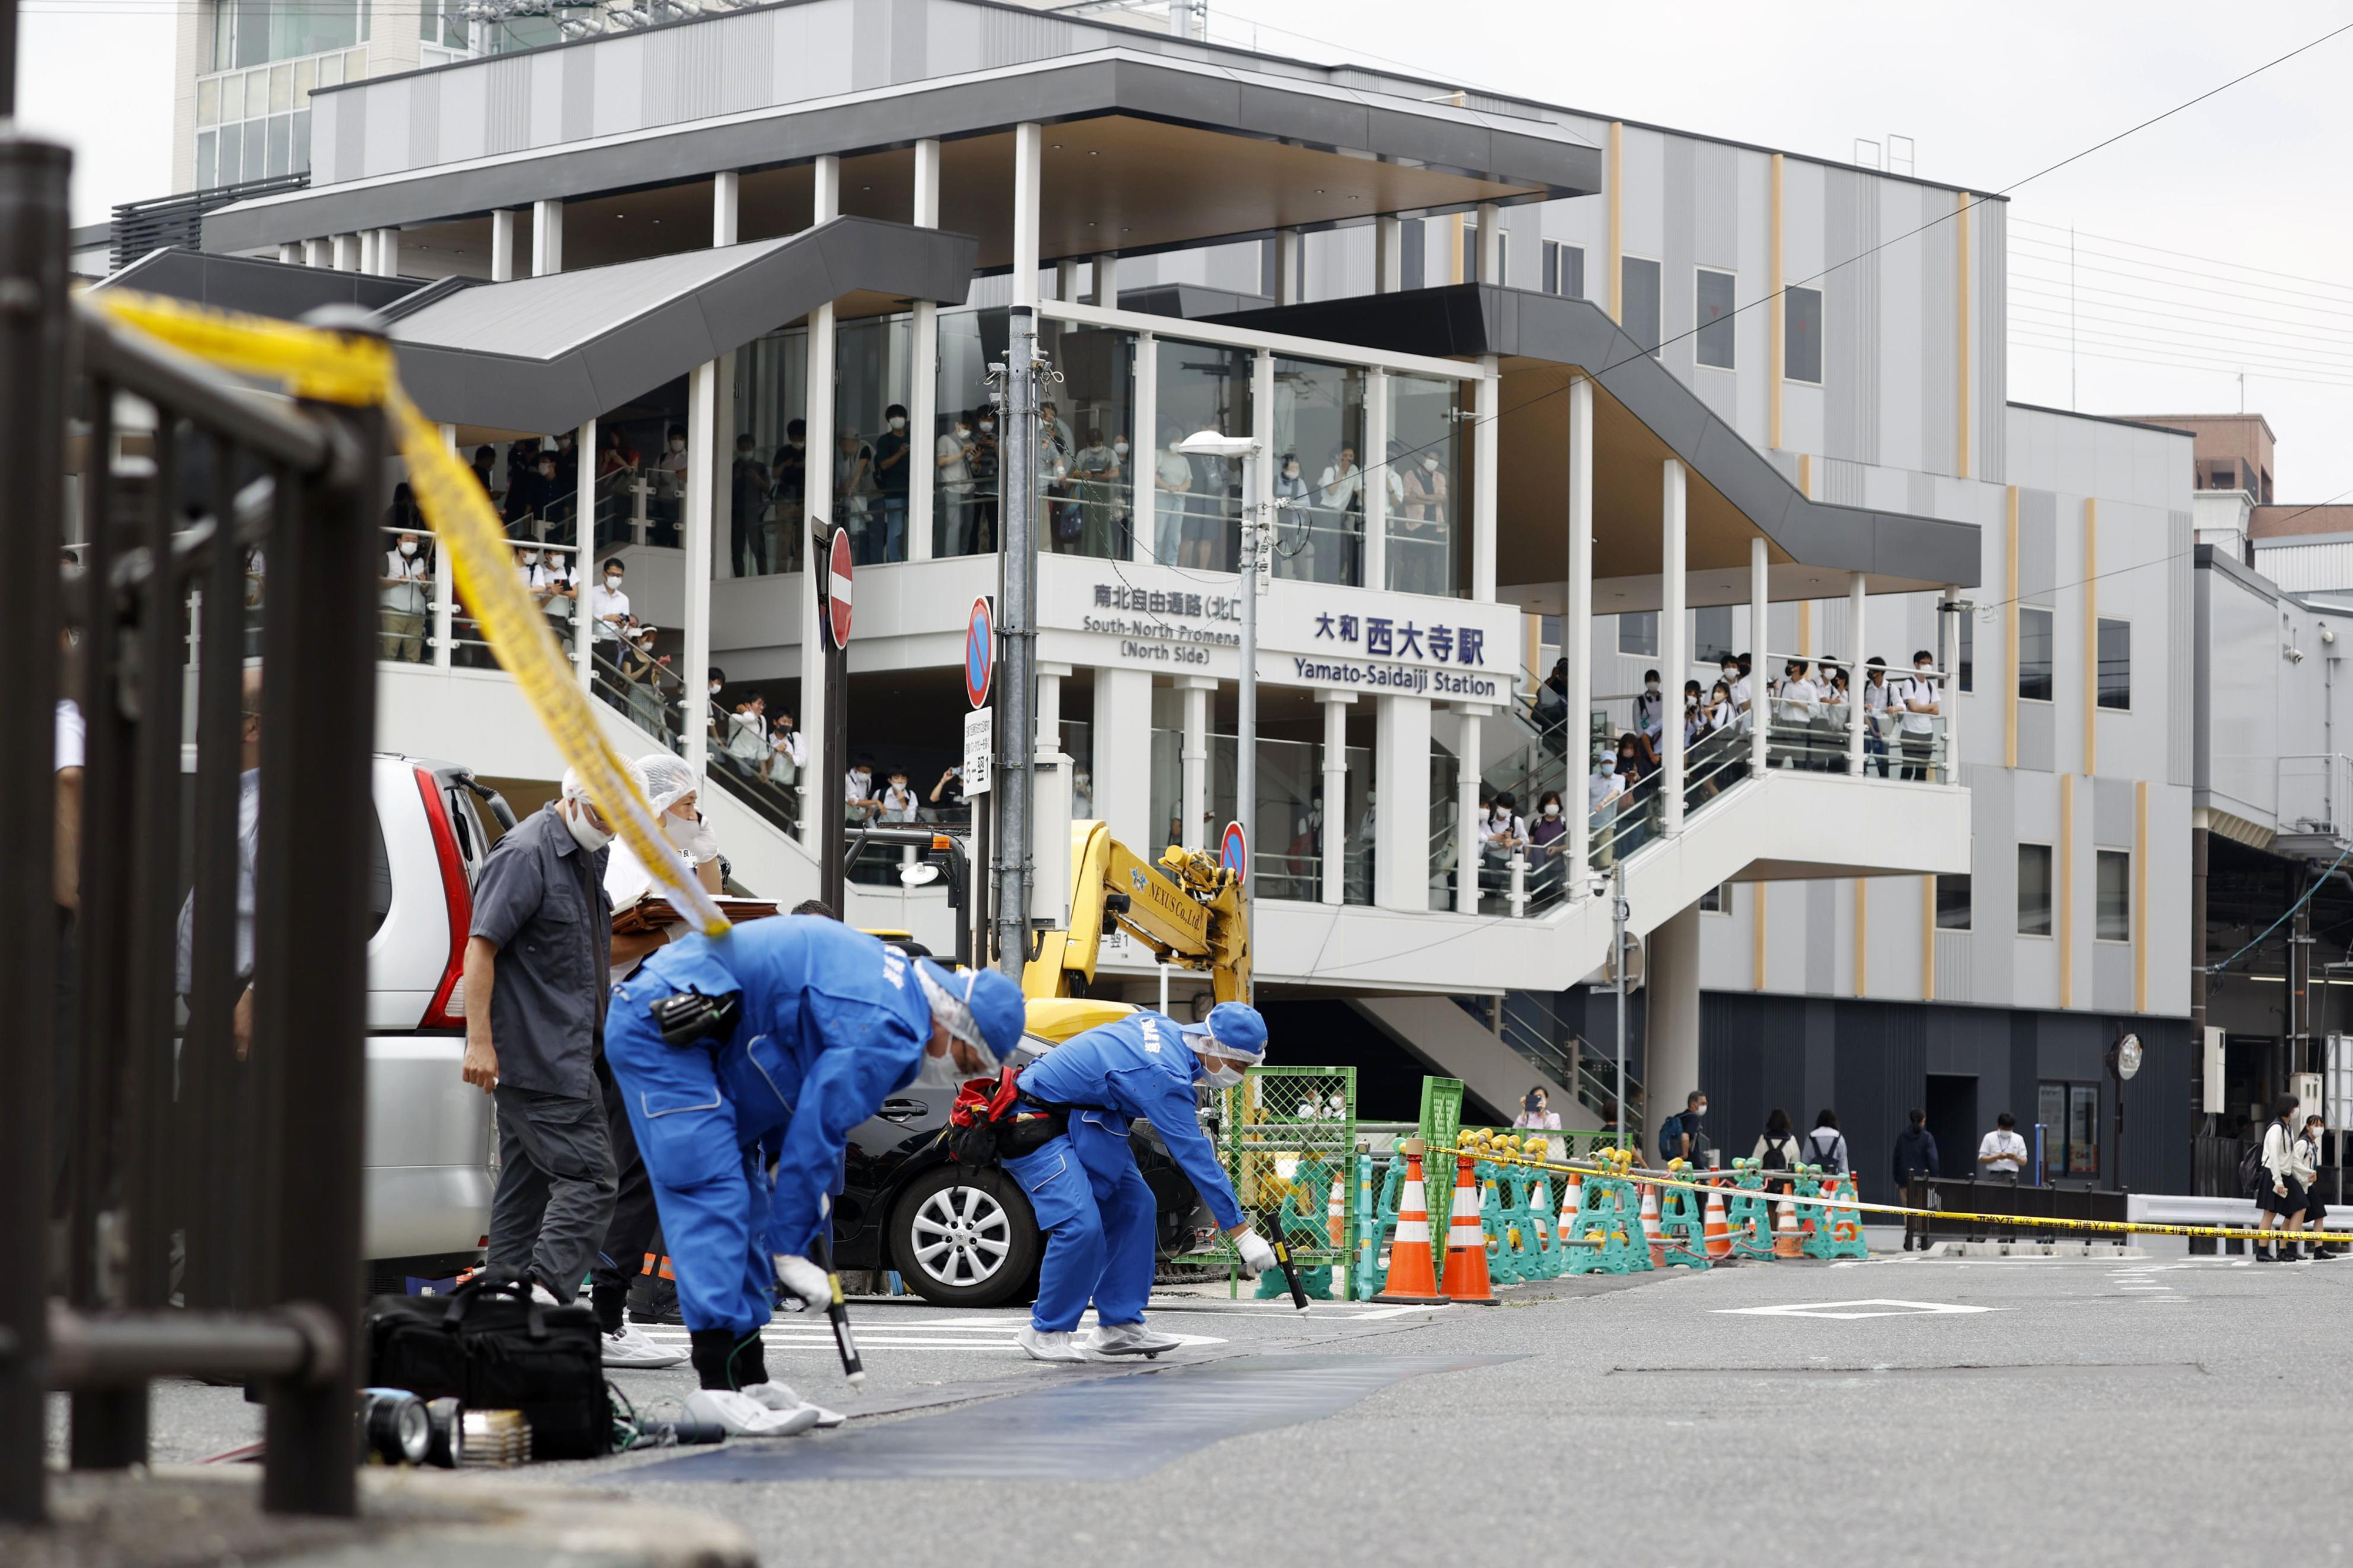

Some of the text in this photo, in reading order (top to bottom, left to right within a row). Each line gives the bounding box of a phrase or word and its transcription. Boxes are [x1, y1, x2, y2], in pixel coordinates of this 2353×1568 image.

[1083, 615, 1241, 645] South-North Promena
[1314, 612, 1484, 665] 大和西大寺駅
[1294, 657, 1496, 696] Yamato-Saidaiji Station
[1149, 882, 1176, 913] NEXUS
